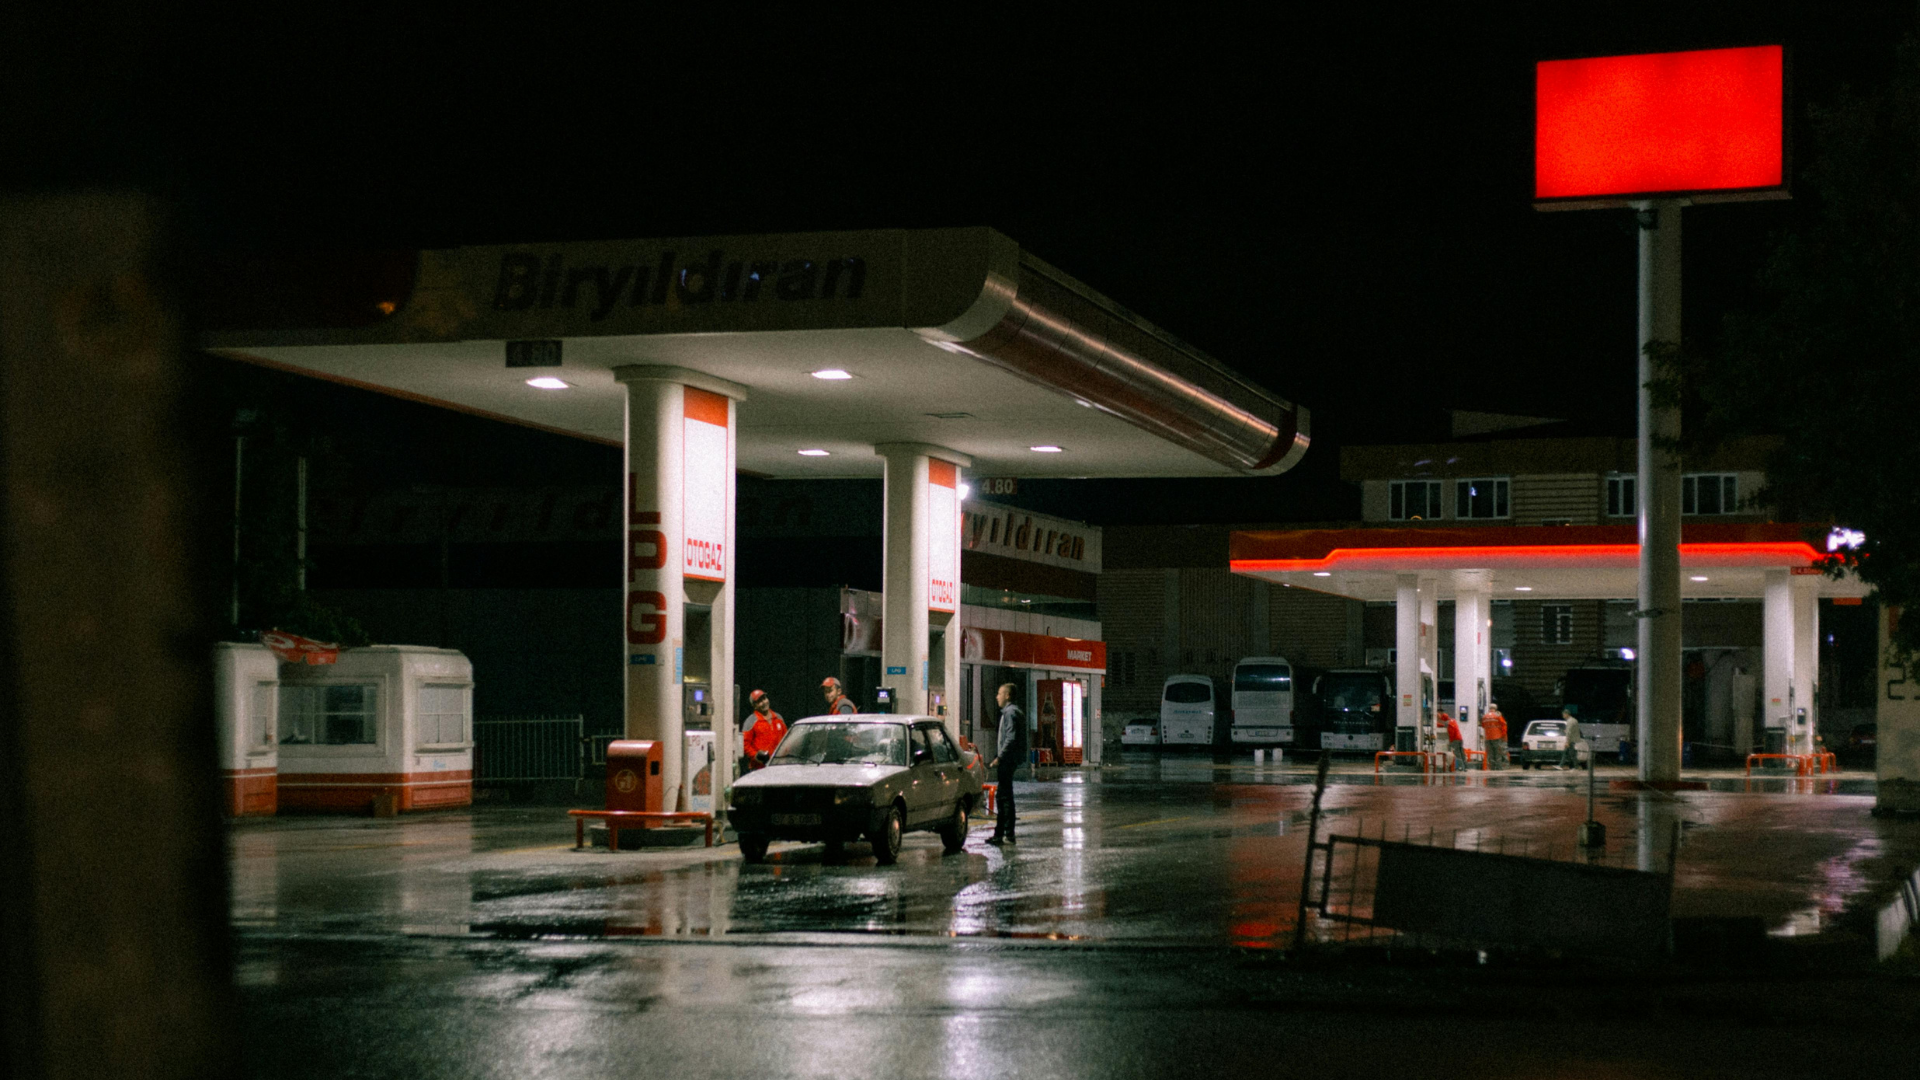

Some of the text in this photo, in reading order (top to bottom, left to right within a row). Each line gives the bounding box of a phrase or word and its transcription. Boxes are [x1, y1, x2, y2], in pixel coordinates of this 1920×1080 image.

[493, 249, 867, 323] Biryıldıran
[981, 478, 1014, 494] 4.80
[961, 511, 1085, 561] ryıldıran
[627, 472, 667, 645] LPG
[687, 537, 722, 571] OTOGAZ
[931, 578, 953, 604] OTOGAZ
[1067, 649, 1092, 662] MARKET
